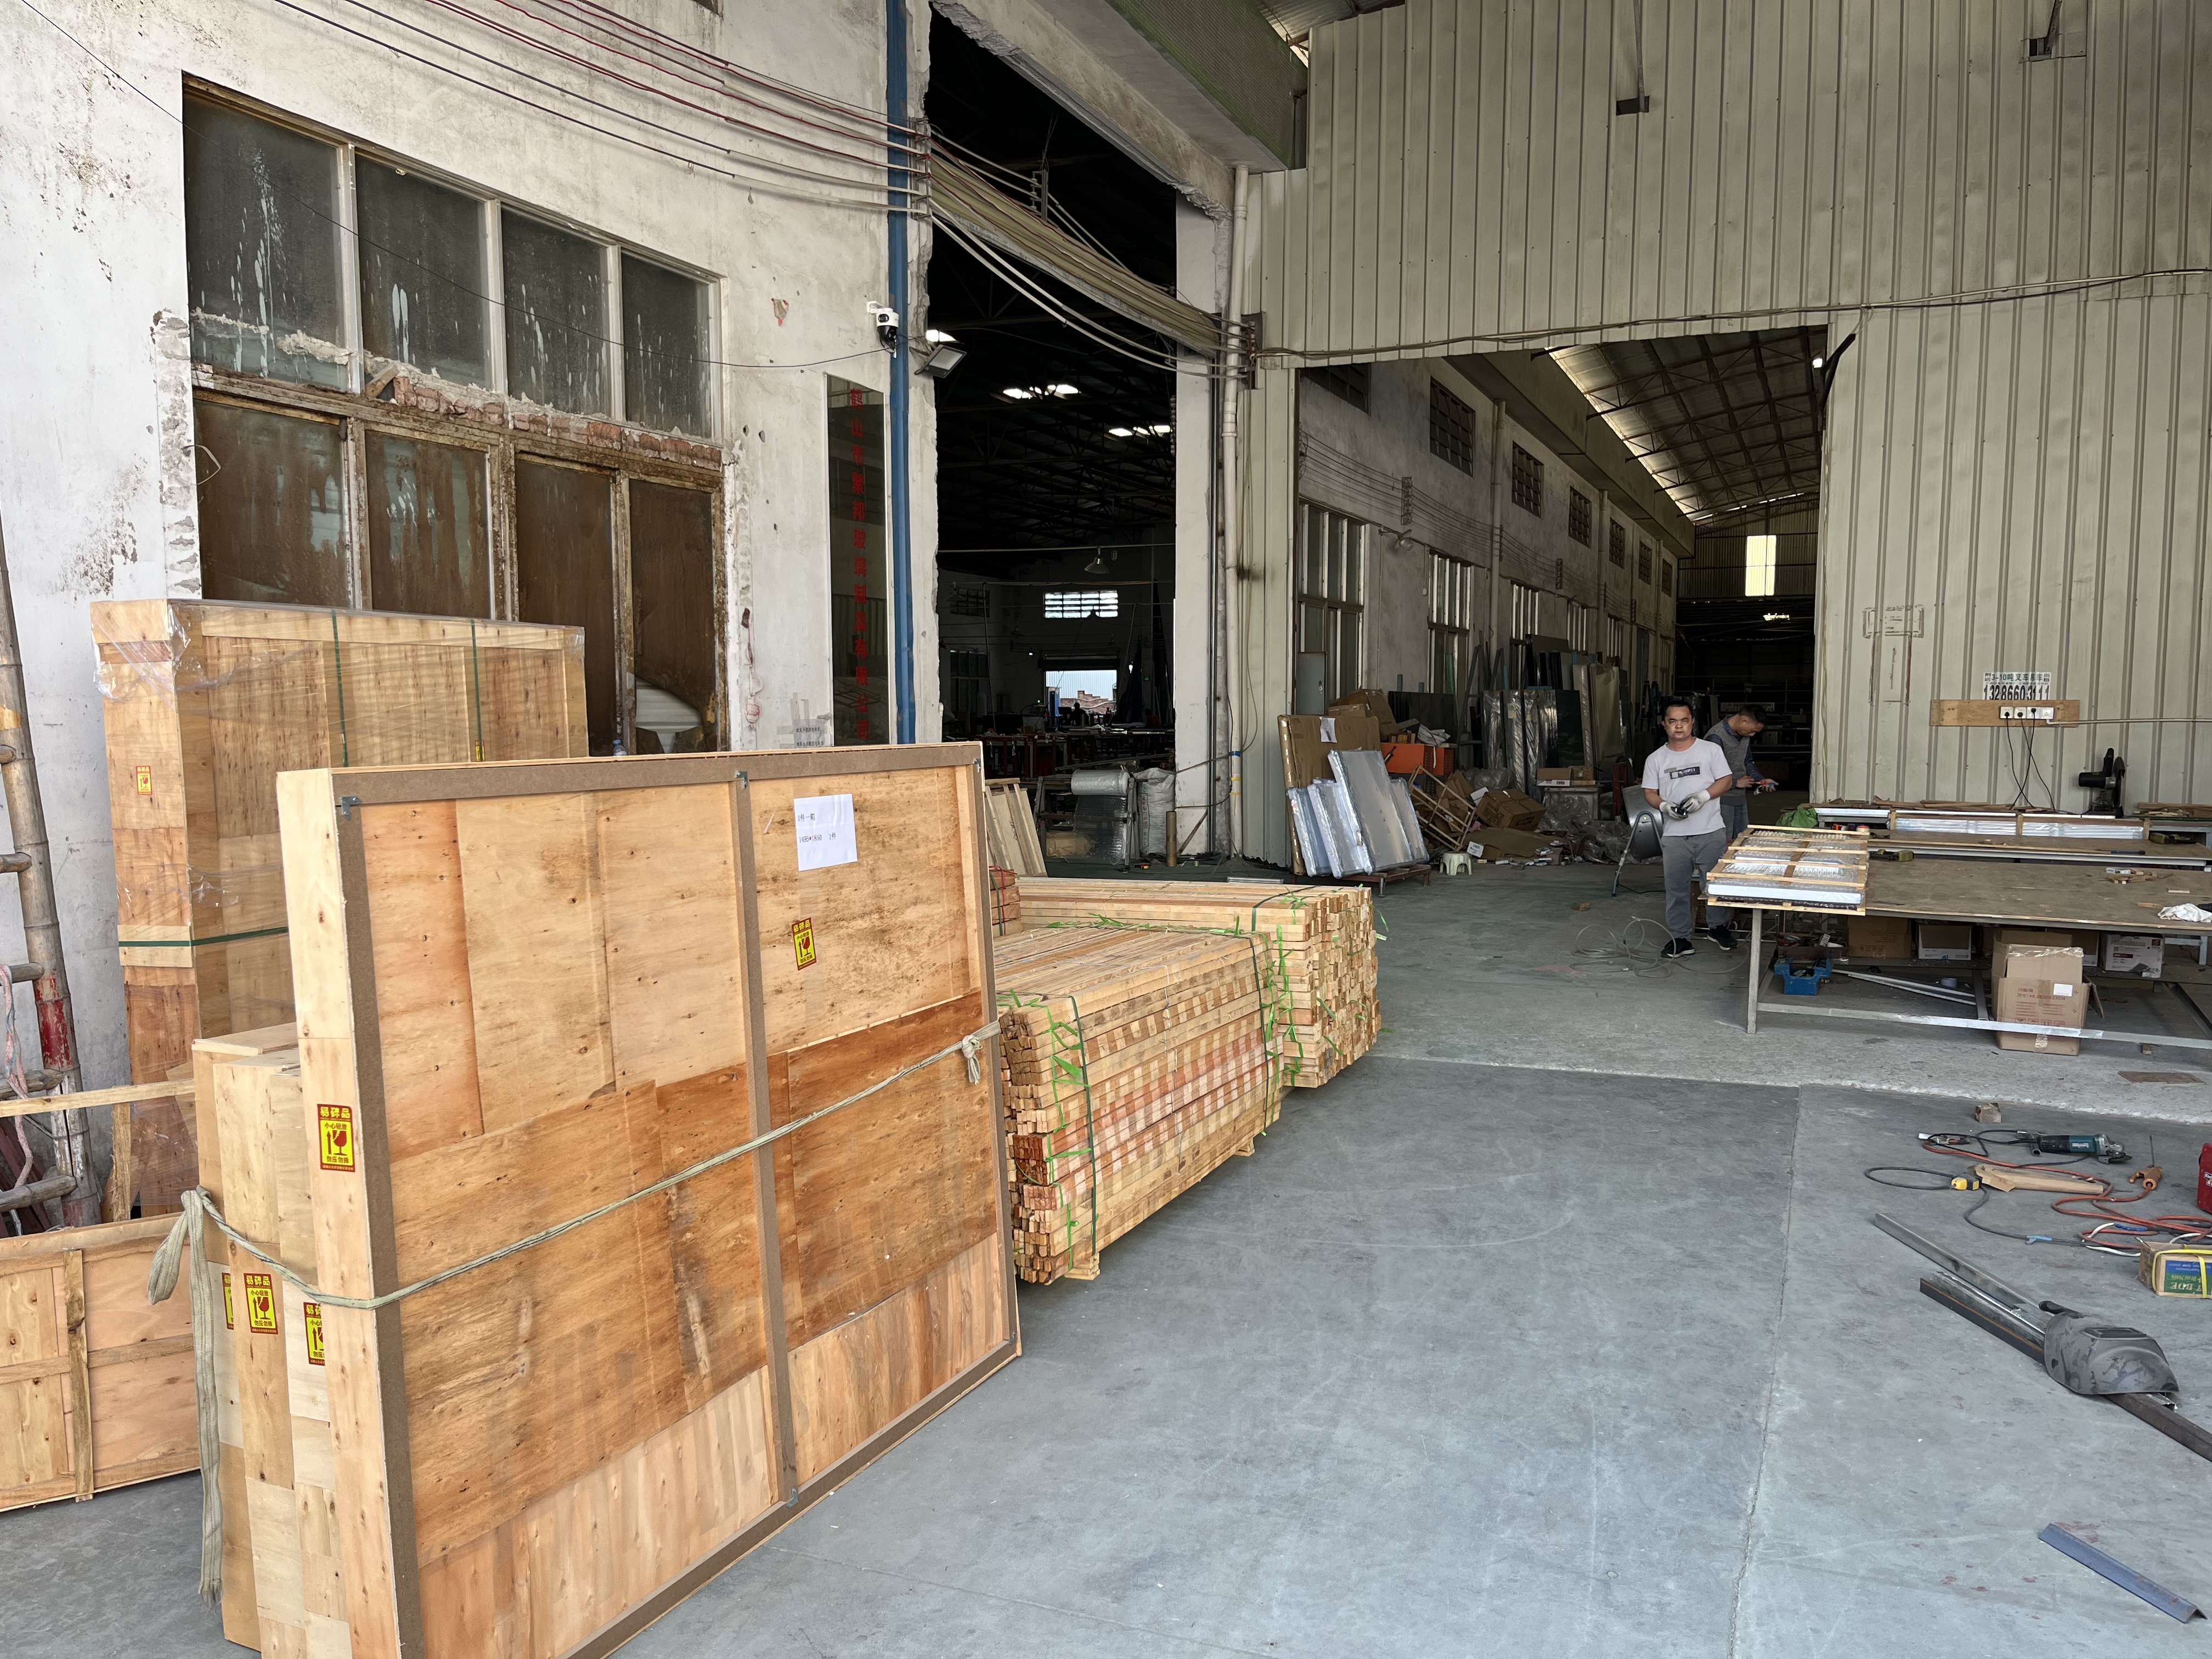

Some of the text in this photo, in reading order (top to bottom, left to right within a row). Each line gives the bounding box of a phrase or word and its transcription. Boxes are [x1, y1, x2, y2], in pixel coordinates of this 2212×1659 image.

[850, 388, 869, 740] 鹤山市聚邦玻璃制品有限公司
[320, 1107, 350, 1119] 易碎品
[246, 1275, 270, 1286] 易碎品
